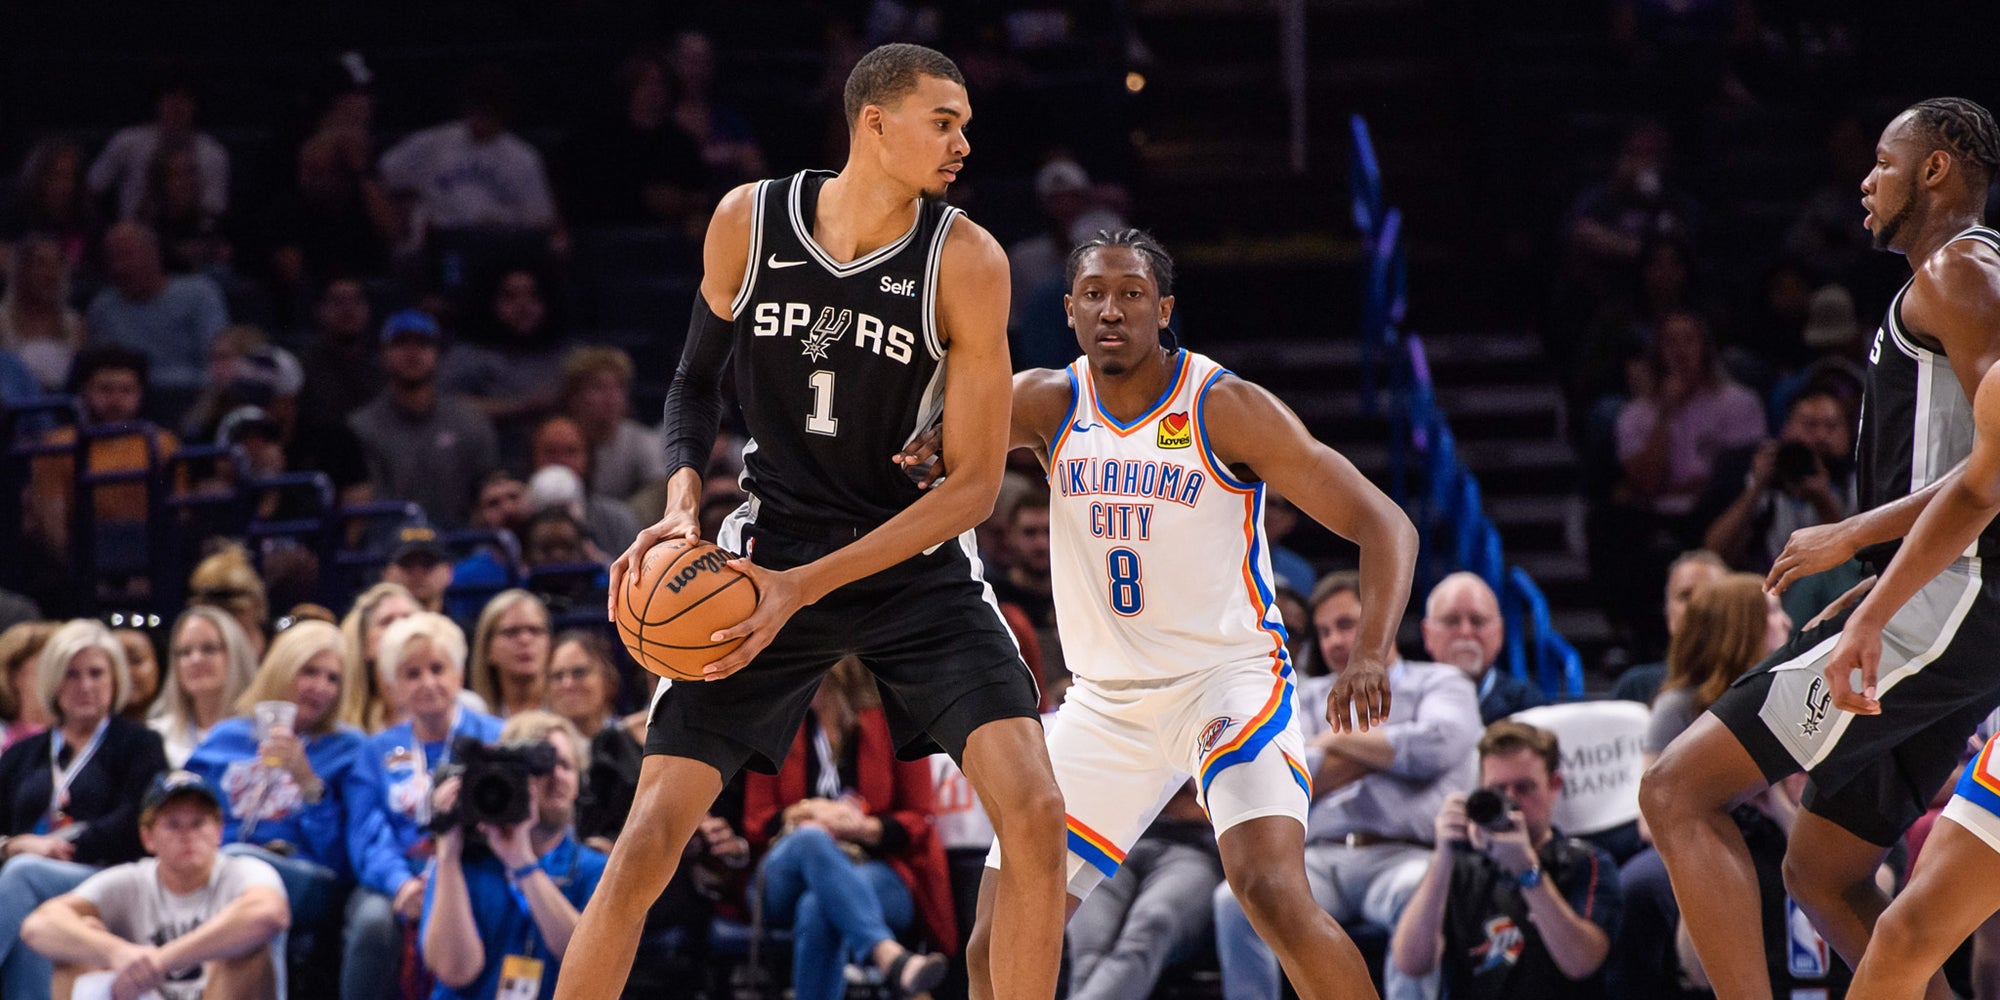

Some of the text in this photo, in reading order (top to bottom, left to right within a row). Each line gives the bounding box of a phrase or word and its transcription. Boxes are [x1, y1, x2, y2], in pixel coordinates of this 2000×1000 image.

[753, 303, 916, 365] SPURS
[805, 370, 839, 437] 1
[1058, 458, 1206, 508] OKLAHOMA
[1089, 501, 1154, 541] CITY
[1105, 545, 1145, 617] 8
